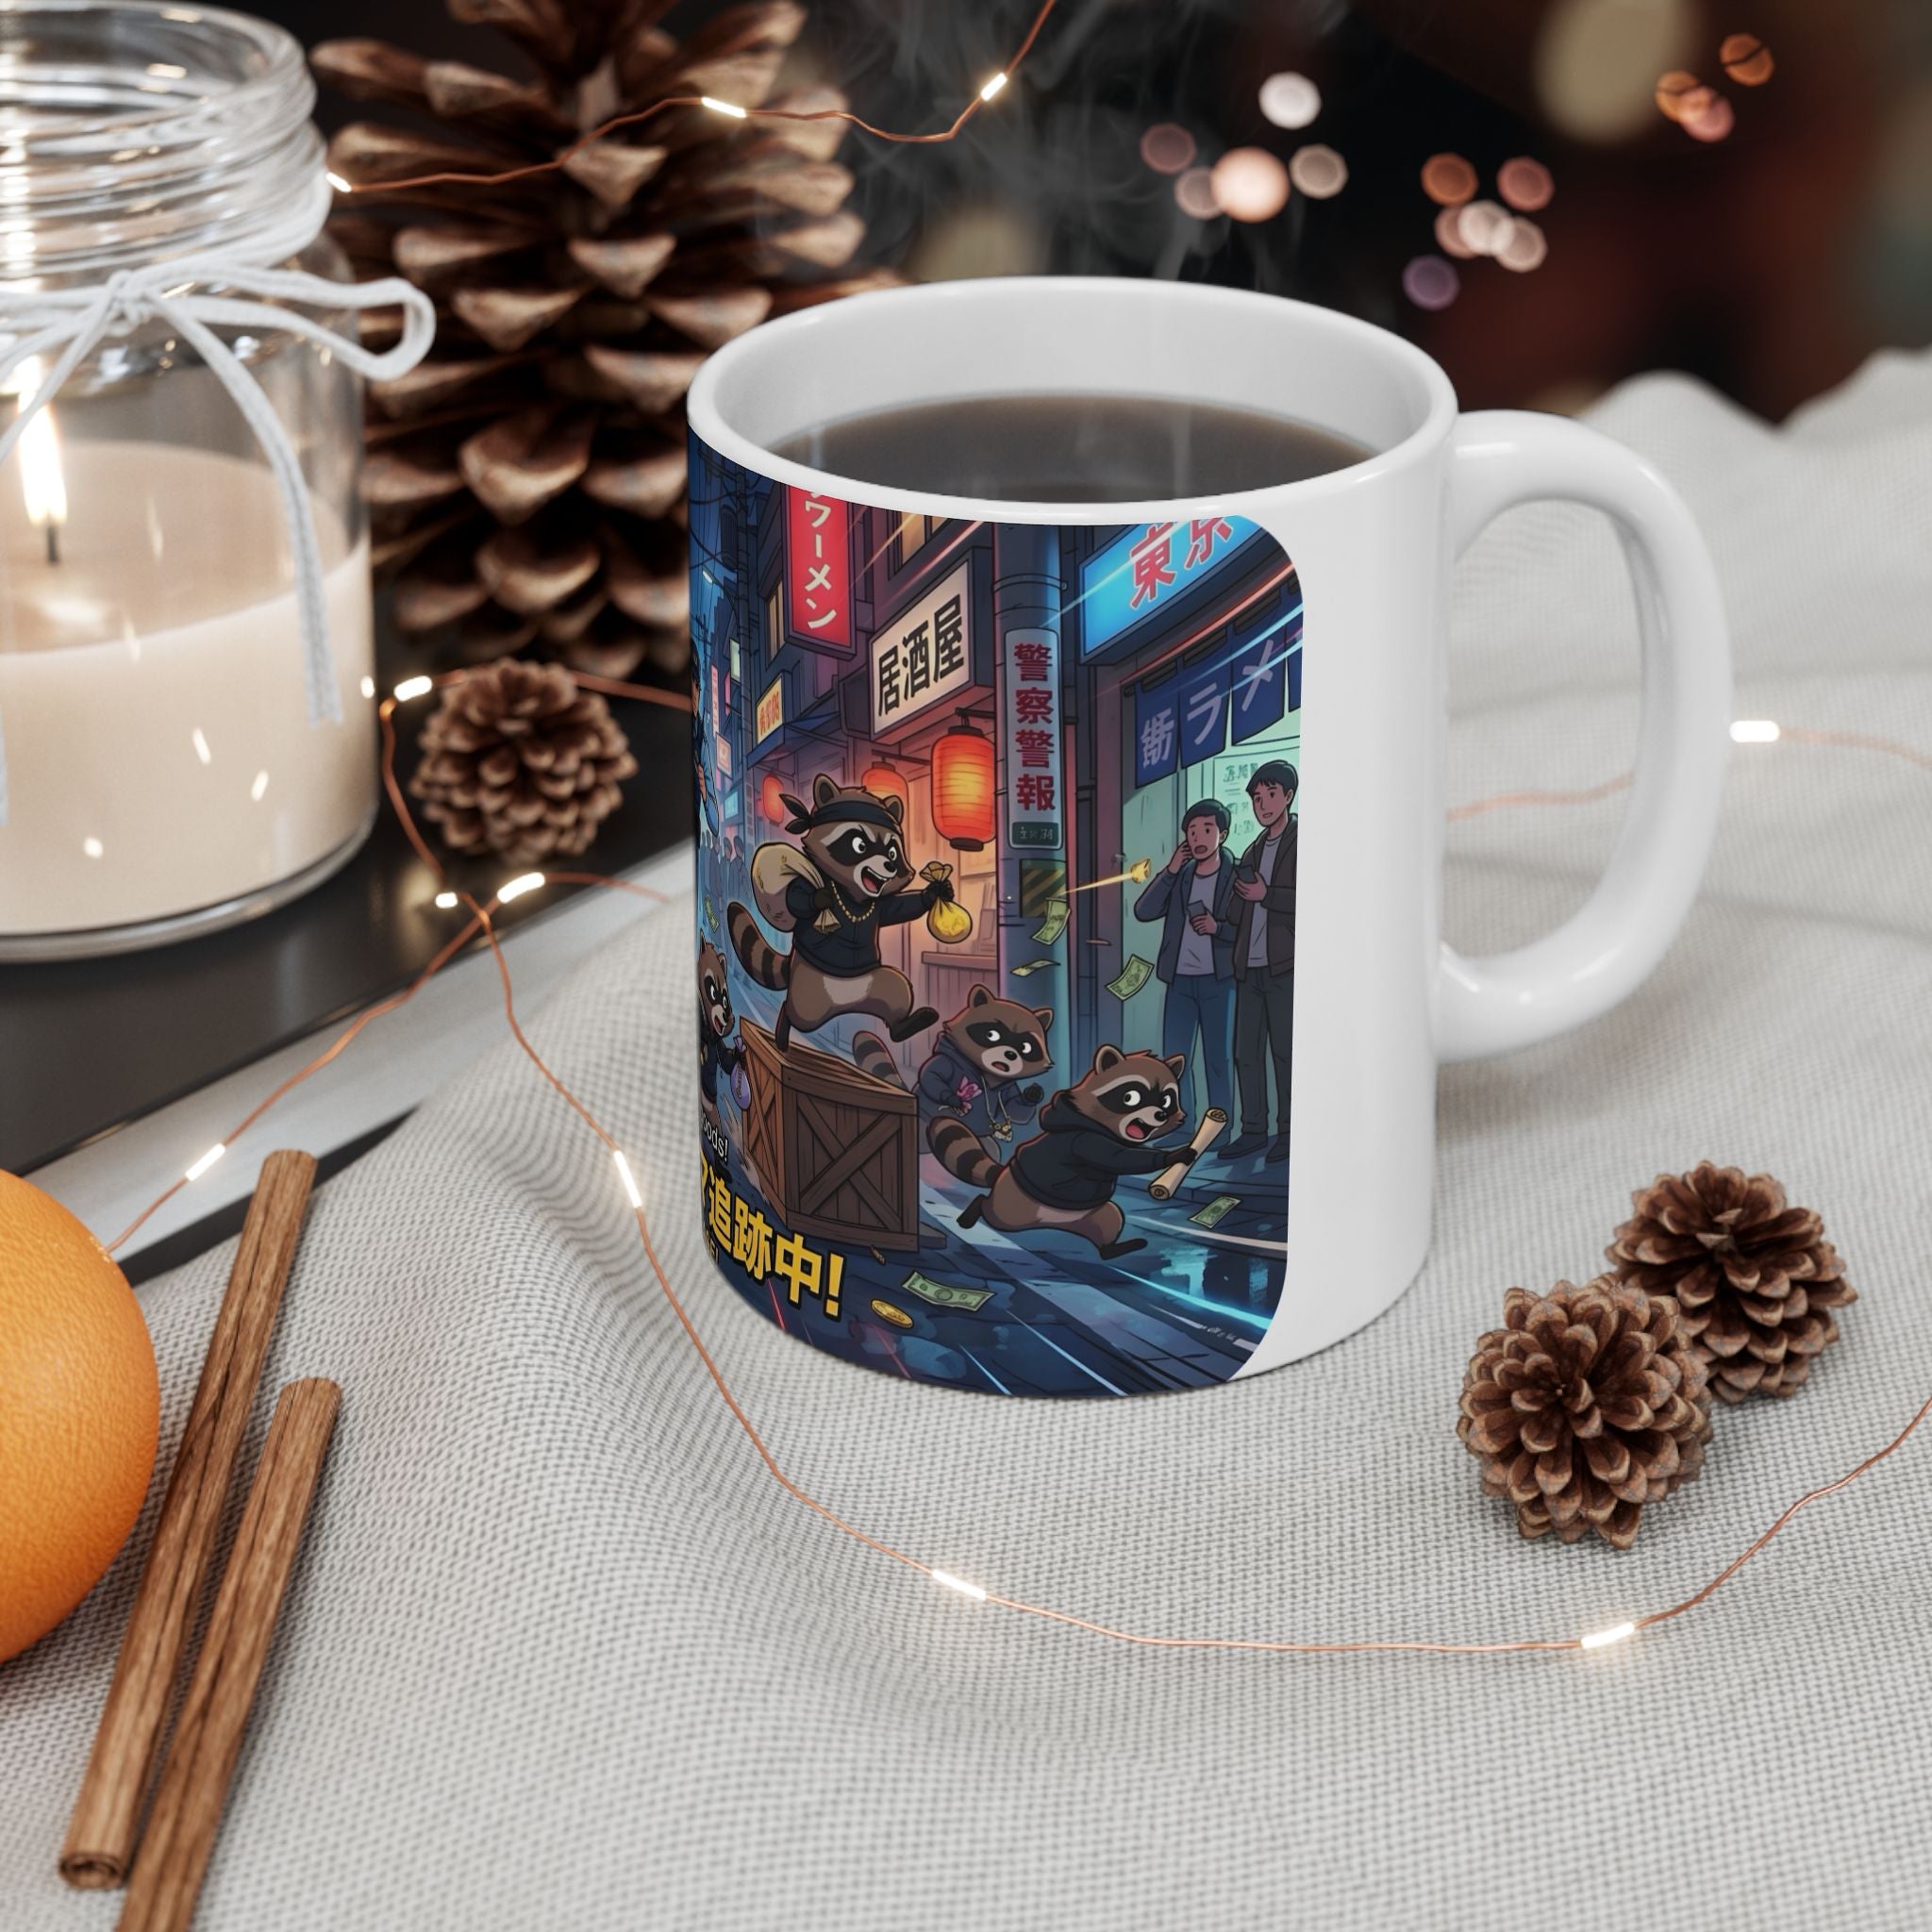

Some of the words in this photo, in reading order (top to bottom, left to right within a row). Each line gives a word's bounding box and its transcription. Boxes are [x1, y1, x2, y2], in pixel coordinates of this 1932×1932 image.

[805, 493, 837, 629] ワーメン
[878, 593, 964, 717] 居酒屋
[1013, 642, 1057, 811] 警察警報
[701, 1109, 728, 1162] oods!
